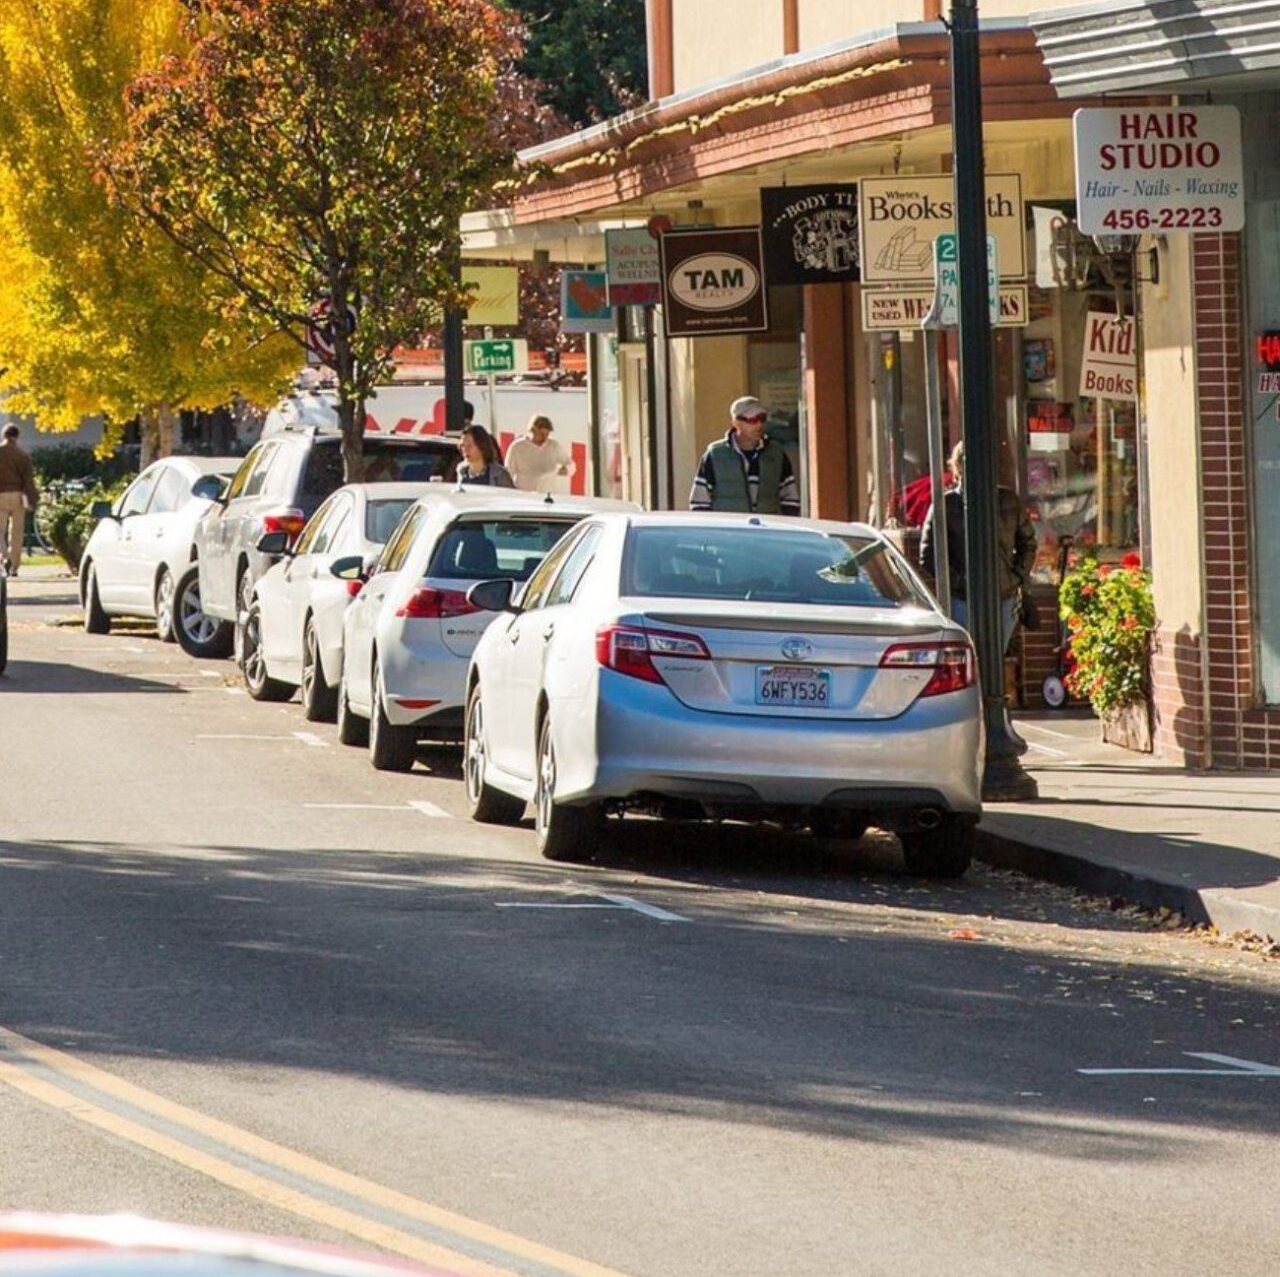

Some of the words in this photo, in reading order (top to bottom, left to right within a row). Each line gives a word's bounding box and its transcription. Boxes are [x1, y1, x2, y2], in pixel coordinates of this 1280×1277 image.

[1120, 113, 1198, 139] HAIR
[1100, 142, 1220, 170] STUDIO
[1085, 181, 1120, 199] Hair
[1132, 179, 1170, 197] Nails
[1186, 178, 1238, 199] Waxing
[868, 193, 1014, 221] Booksth
[1103, 207, 1222, 230] 456-2223
[941, 238, 955, 259] 2
[683, 268, 744, 290] TAM
[872, 299, 899, 309] NEW
[872, 310, 901, 320] USED
[1089, 319, 1135, 356] Kid
[473, 346, 511, 370] Parking
[1085, 370, 1133, 396] Books
[762, 680, 826, 701] 6WFY536
